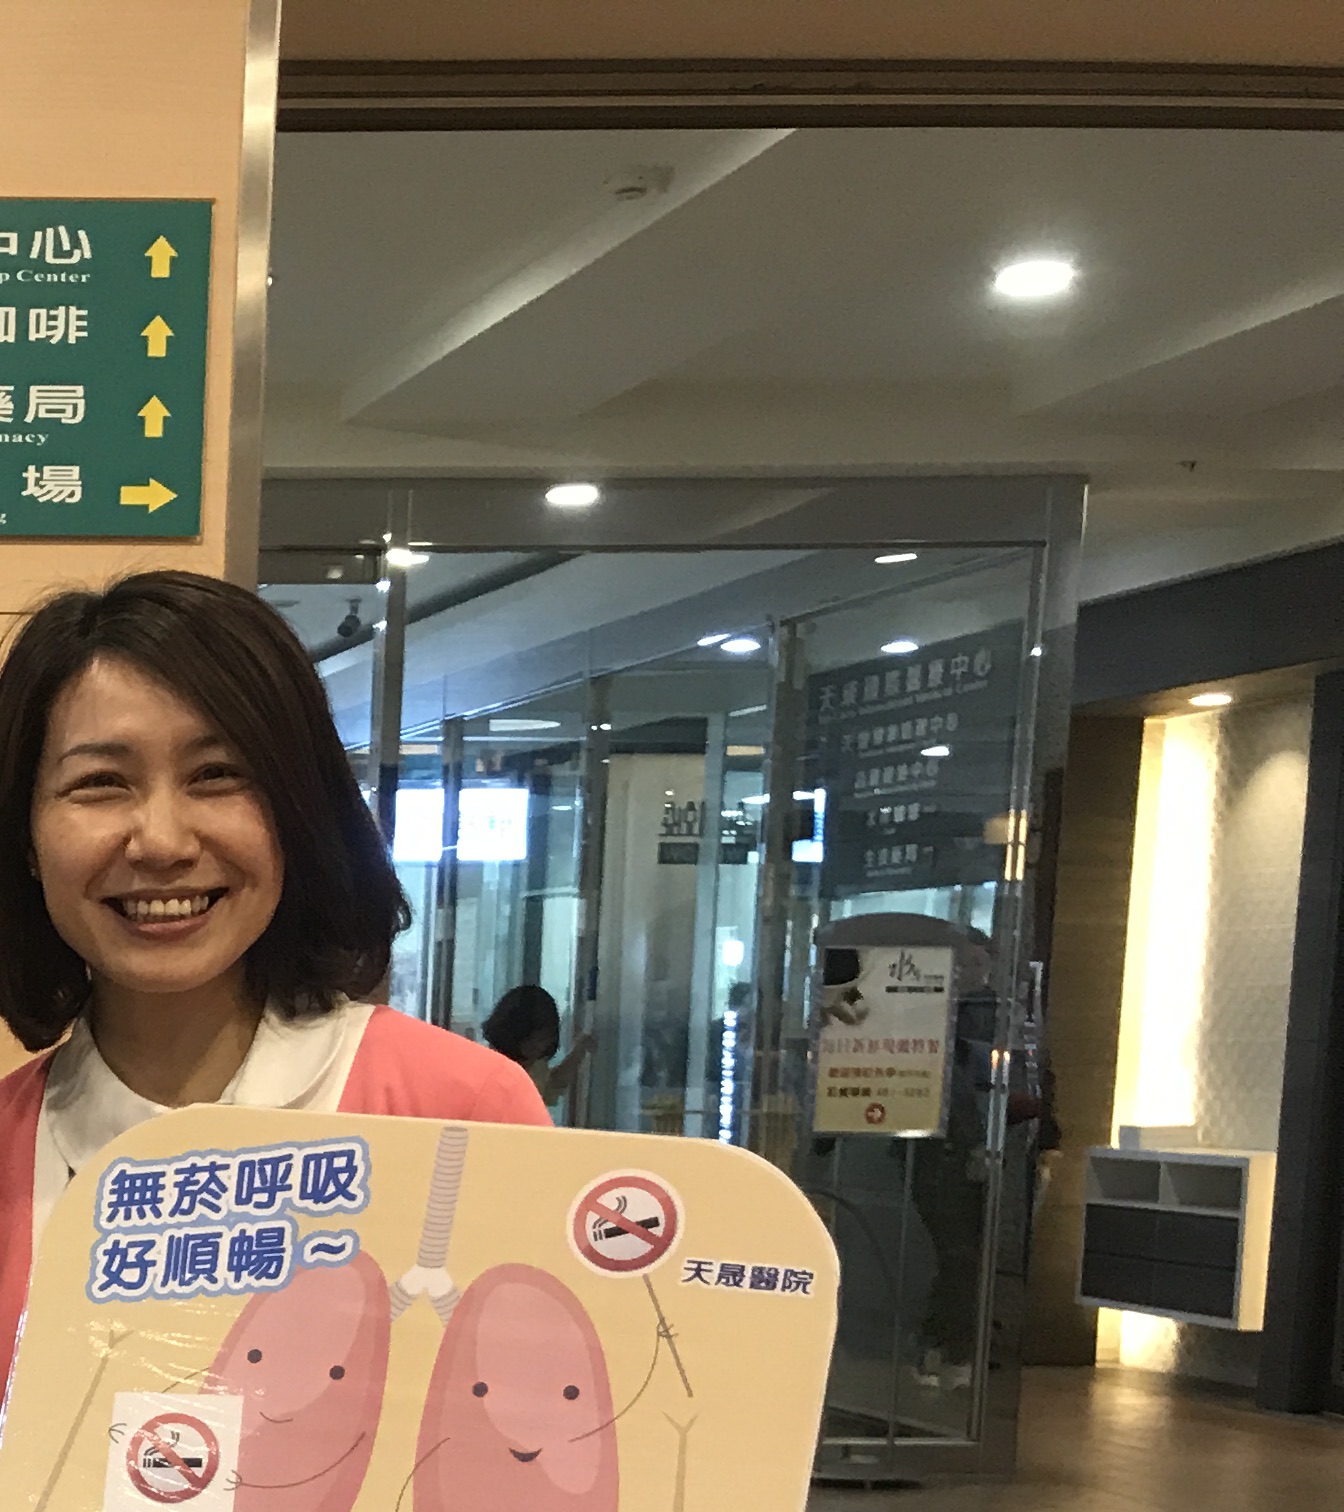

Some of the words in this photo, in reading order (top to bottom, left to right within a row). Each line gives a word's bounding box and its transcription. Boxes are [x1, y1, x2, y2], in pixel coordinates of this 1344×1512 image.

[17, 270, 91, 283] Center
[107, 1148, 360, 1222] 無菸呼吸
[682, 1259, 814, 1296] 天晟醫院
